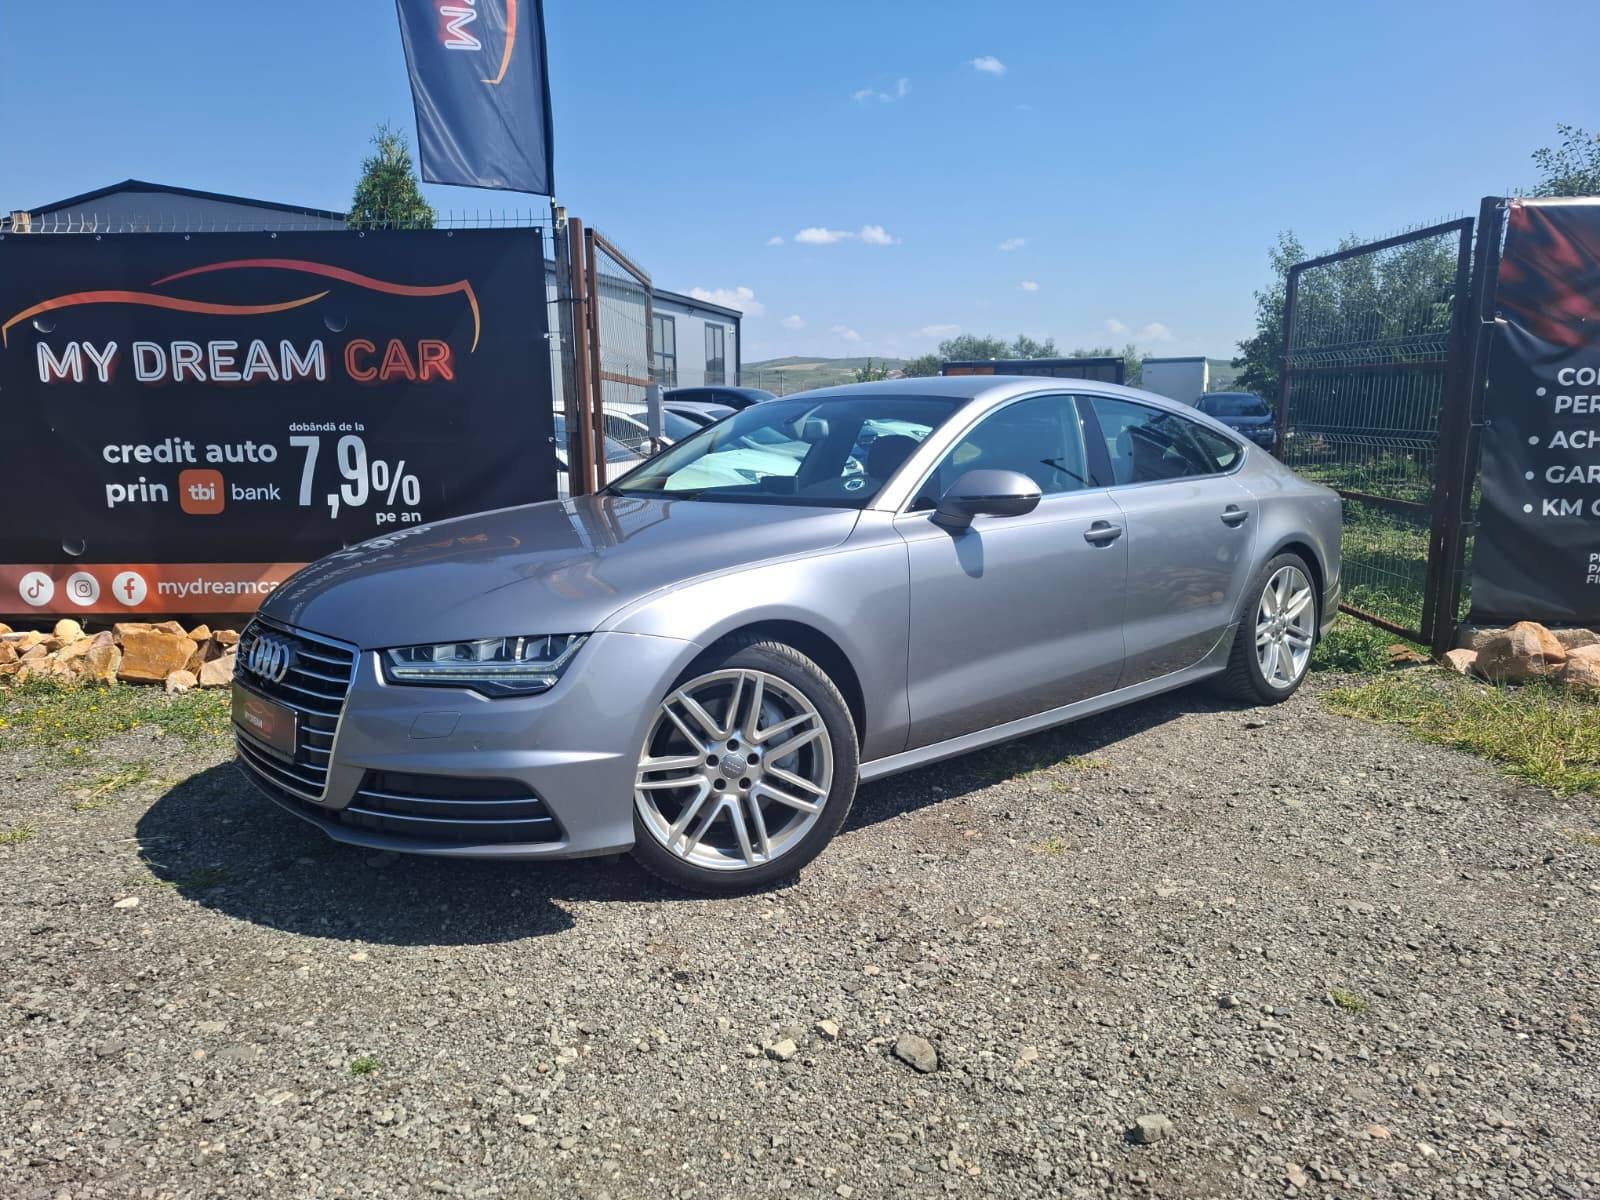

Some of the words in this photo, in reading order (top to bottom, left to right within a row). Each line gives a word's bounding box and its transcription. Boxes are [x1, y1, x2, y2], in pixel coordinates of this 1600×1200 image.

[36, 341, 118, 383] MY
[132, 339, 326, 382] DREAM
[344, 340, 453, 381] CAR
[1557, 367, 1600, 386] CO
[339, 422, 353, 431] de
[355, 422, 365, 431] la
[103, 437, 197, 463] credit
[205, 441, 278, 463] auto
[289, 434, 421, 519] 7,9%
[1545, 465, 1600, 483] GAR
[105, 476, 168, 508] prin
[188, 482, 215, 500] tbi
[231, 483, 281, 500] bank
[1542, 498, 1583, 516] KM
[375, 512, 397, 525] pe
[401, 511, 422, 522] an
[1586, 574, 1600, 584] FI
